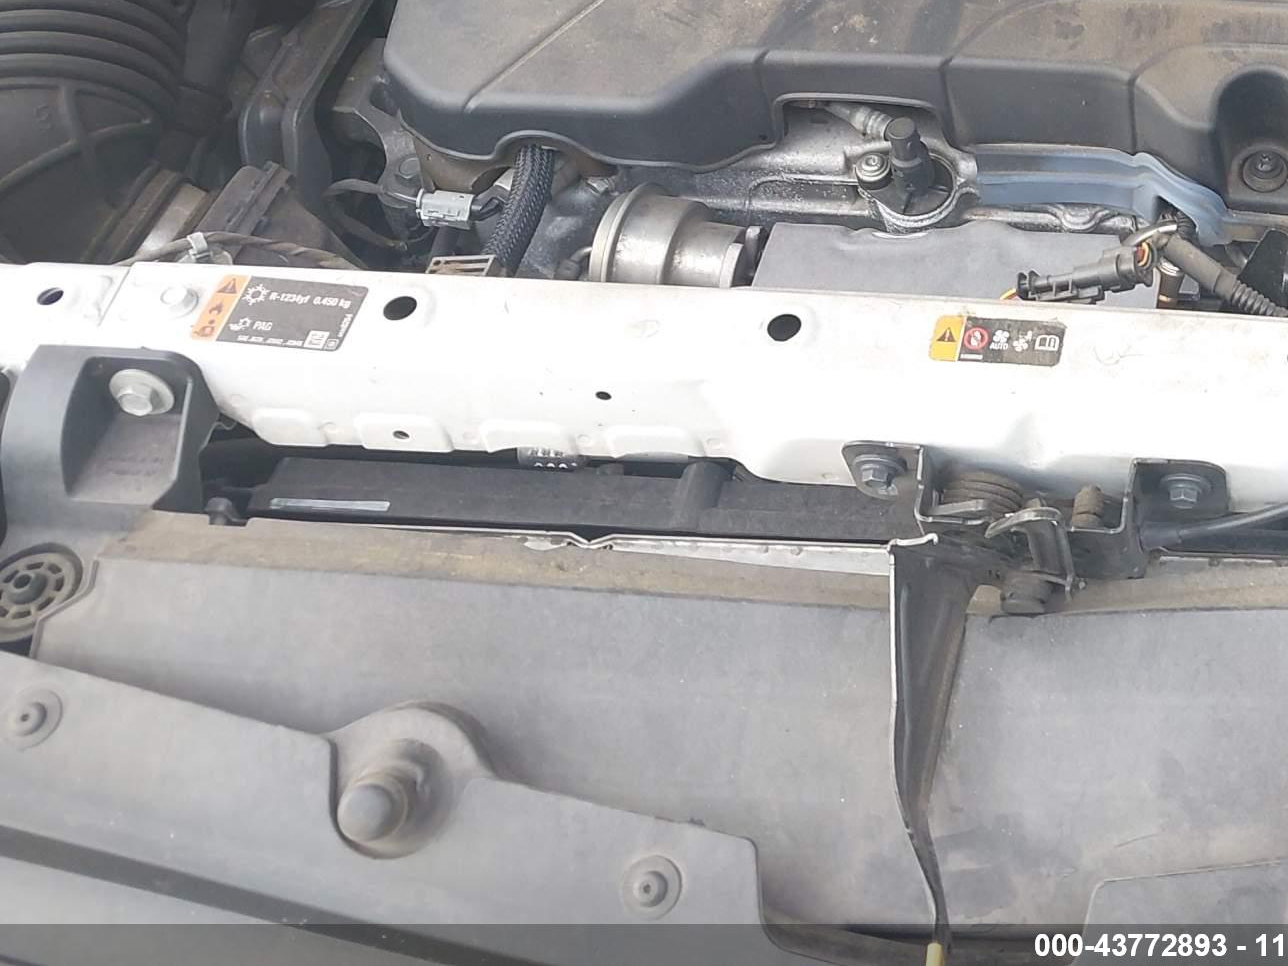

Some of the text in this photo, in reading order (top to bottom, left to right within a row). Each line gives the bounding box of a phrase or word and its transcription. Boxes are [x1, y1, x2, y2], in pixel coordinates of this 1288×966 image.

[312, 297, 338, 307] 0.450
[338, 298, 352, 309] kg
[253, 321, 273, 331] PAG
[989, 342, 1009, 350] AUTO
